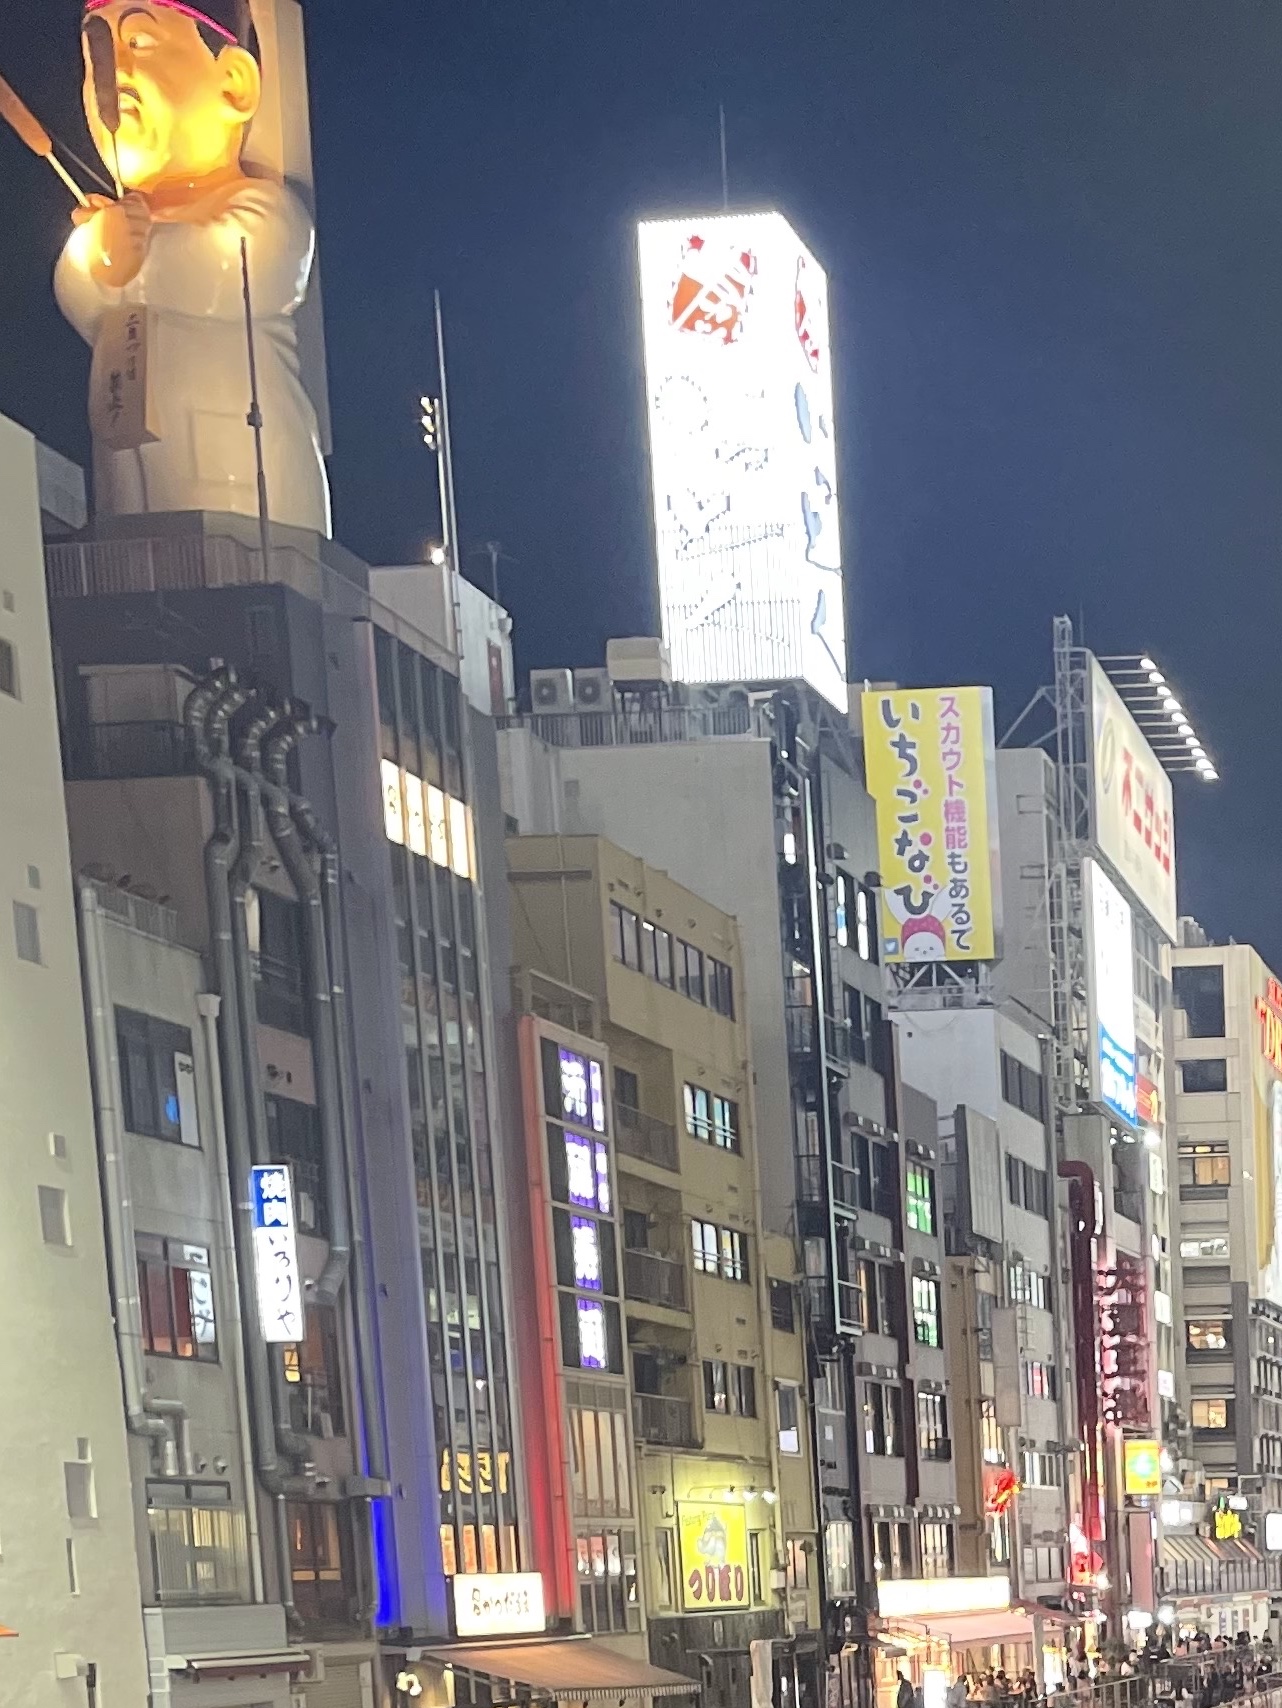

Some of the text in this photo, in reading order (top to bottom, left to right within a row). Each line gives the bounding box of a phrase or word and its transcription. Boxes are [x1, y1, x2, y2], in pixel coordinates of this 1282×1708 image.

[881, 699, 939, 916] いちごなび
[269, 1234, 296, 1336] いろりや
